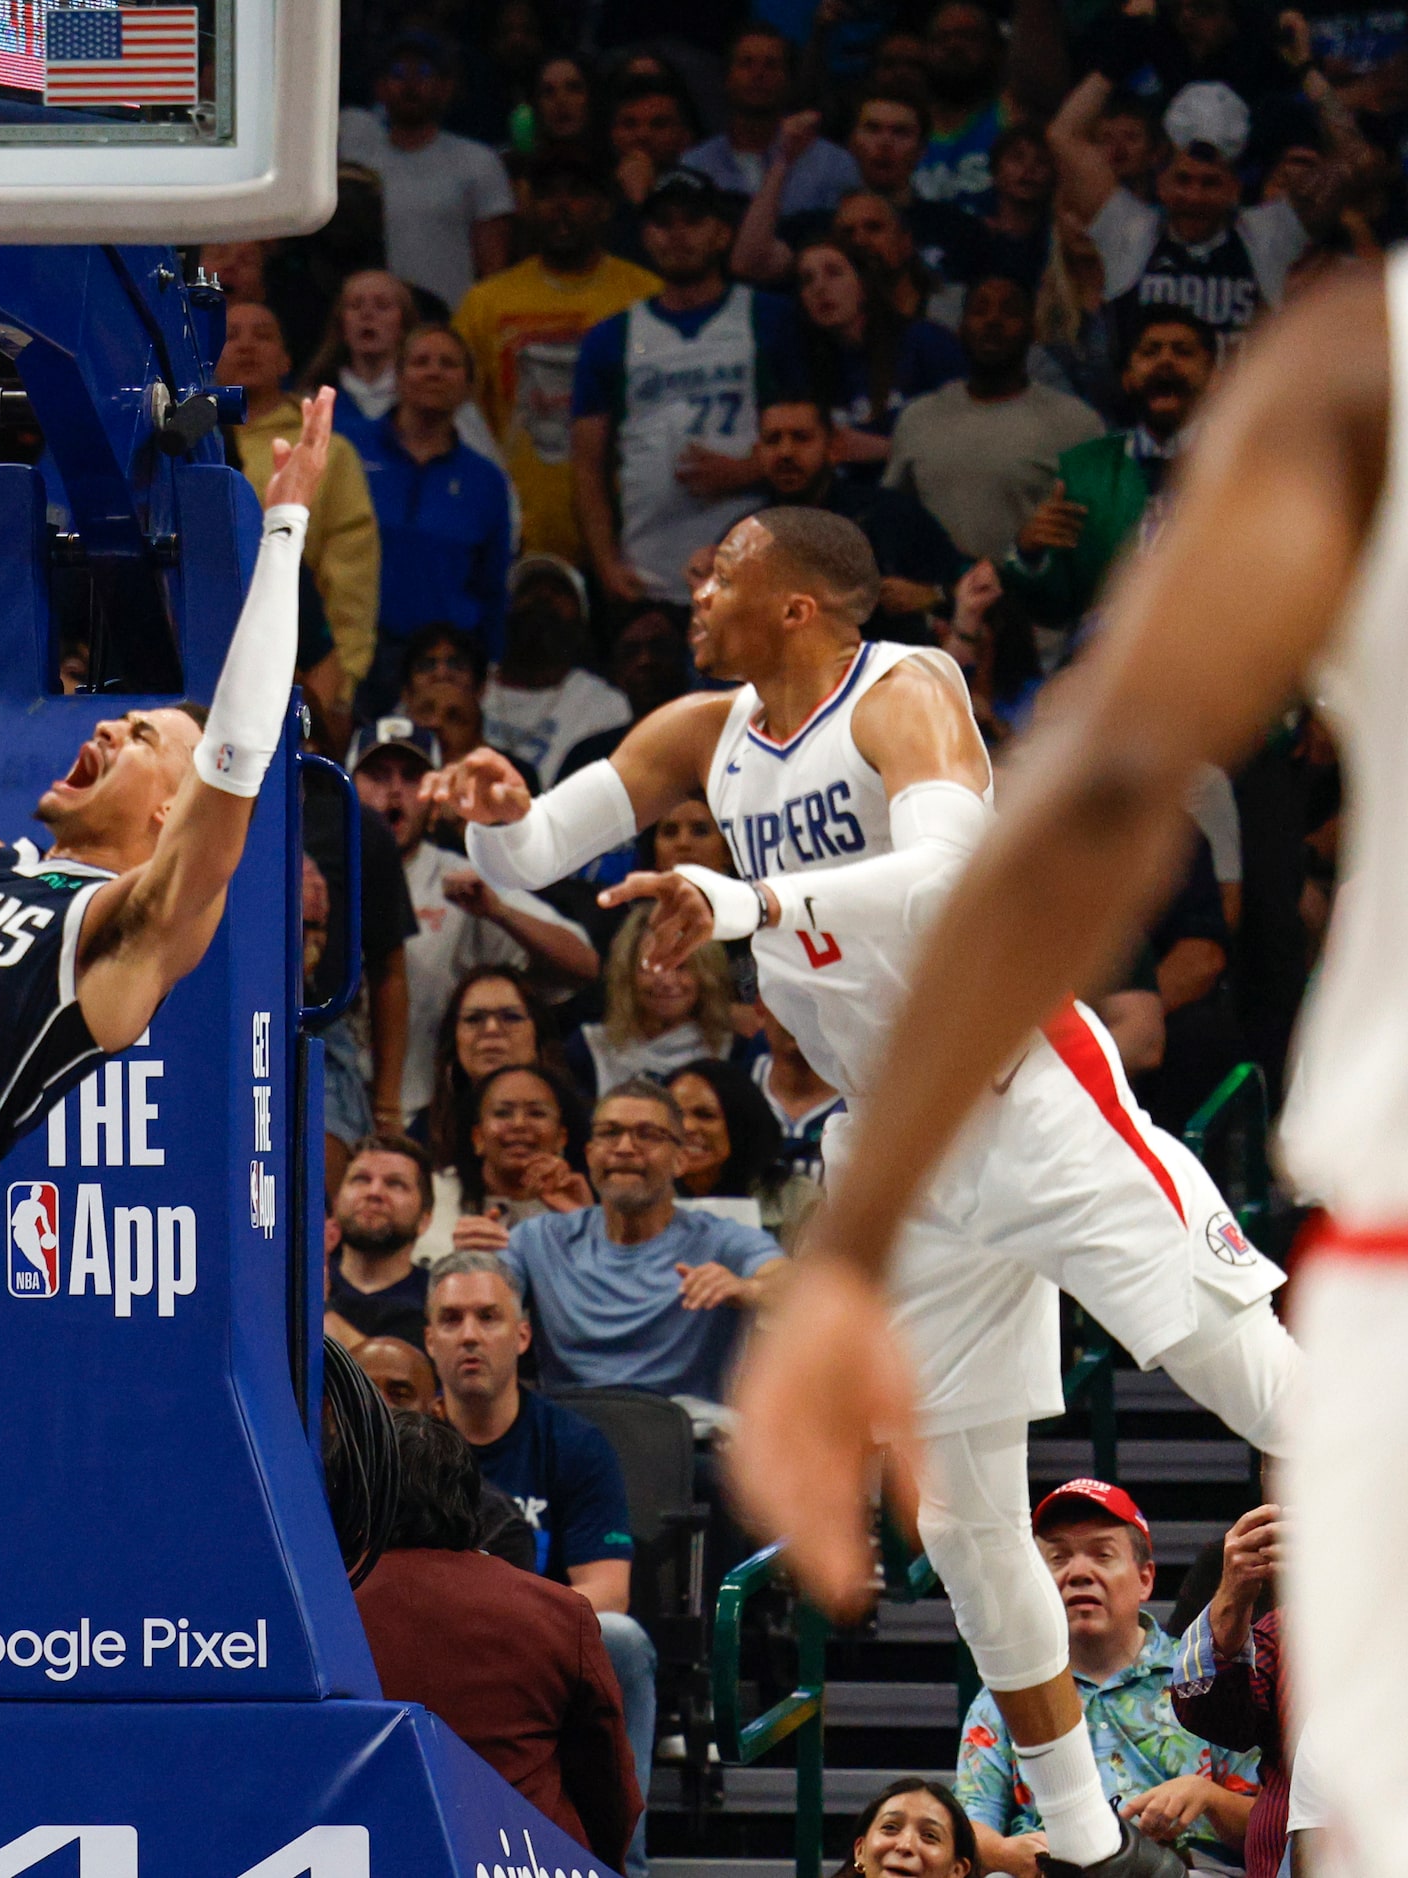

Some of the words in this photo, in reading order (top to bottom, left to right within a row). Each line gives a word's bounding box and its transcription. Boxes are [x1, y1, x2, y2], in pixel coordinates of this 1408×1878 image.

[252, 1011, 271, 1078] GET
[47, 1060, 165, 1167] THE
[253, 1086, 272, 1152] THE
[259, 1161, 275, 1239] App
[15, 1271, 41, 1290] NBA
[68, 1183, 197, 1317] App
[143, 1617, 267, 1669] Pixel
